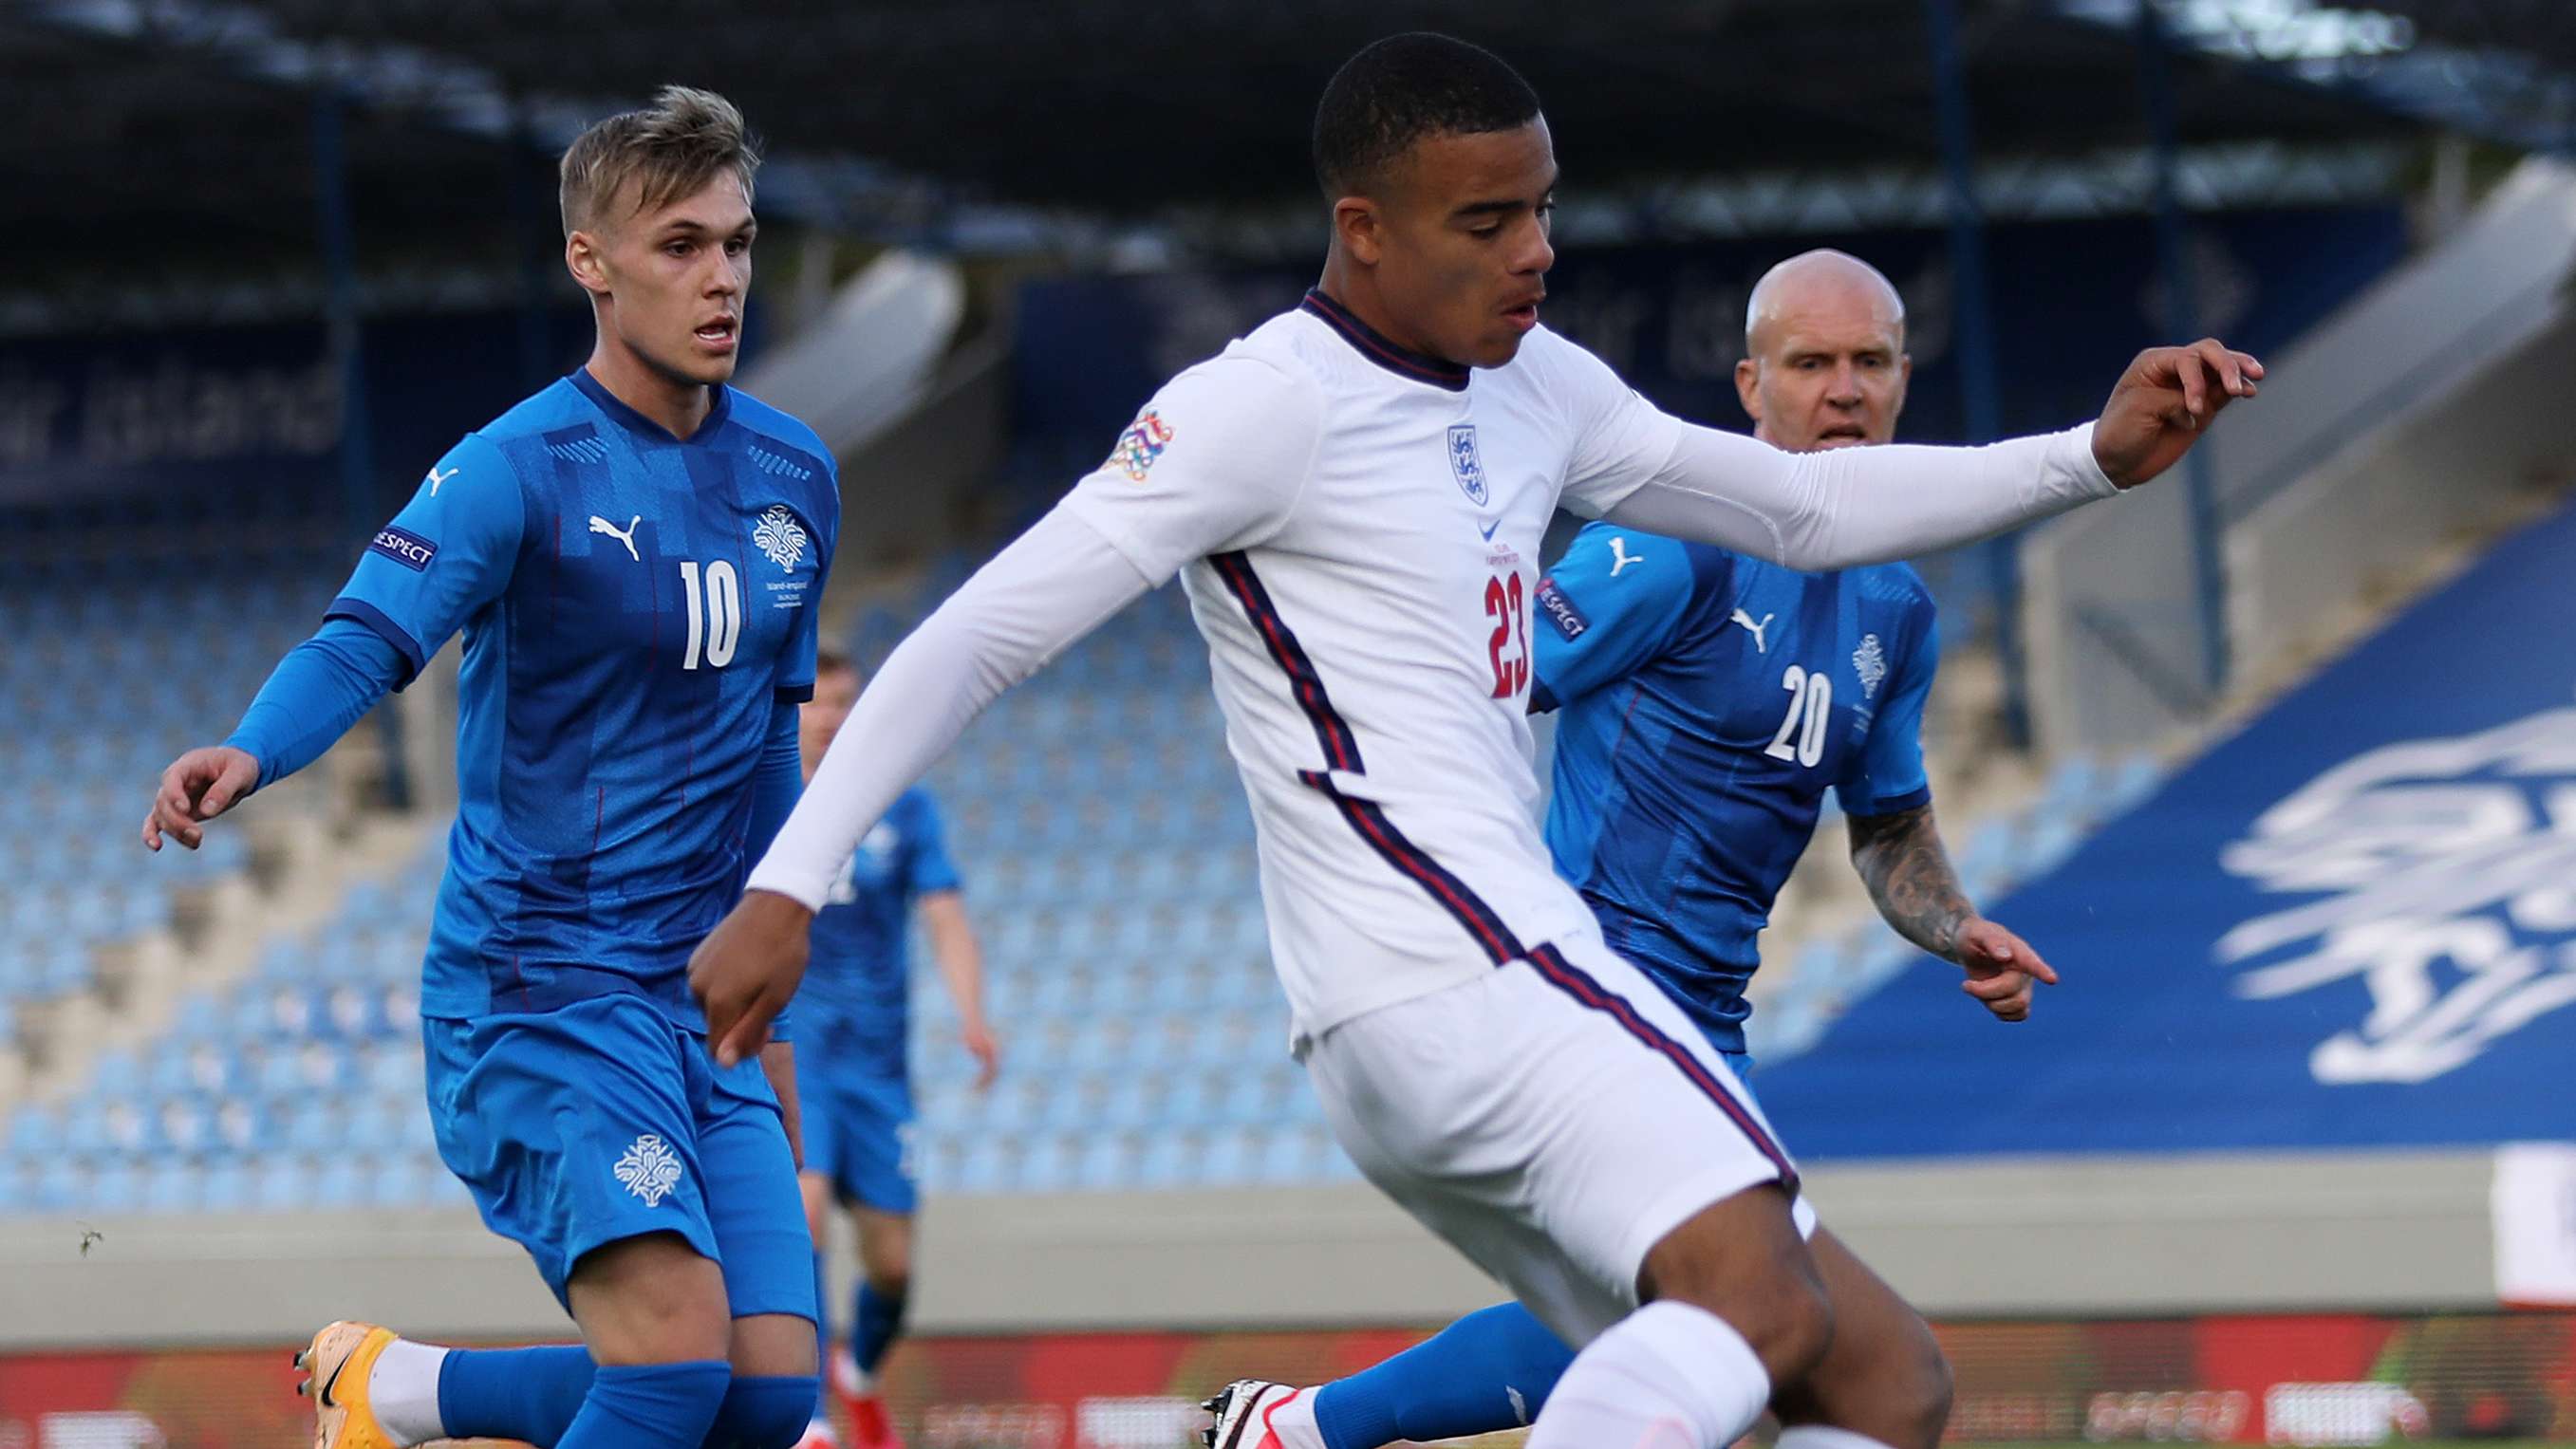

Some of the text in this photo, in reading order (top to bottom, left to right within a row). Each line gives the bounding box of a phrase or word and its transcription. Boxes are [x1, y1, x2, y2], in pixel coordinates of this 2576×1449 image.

[680, 560, 740, 670] 10
[1485, 570, 1528, 698] 23
[1764, 664, 1832, 768] 20
